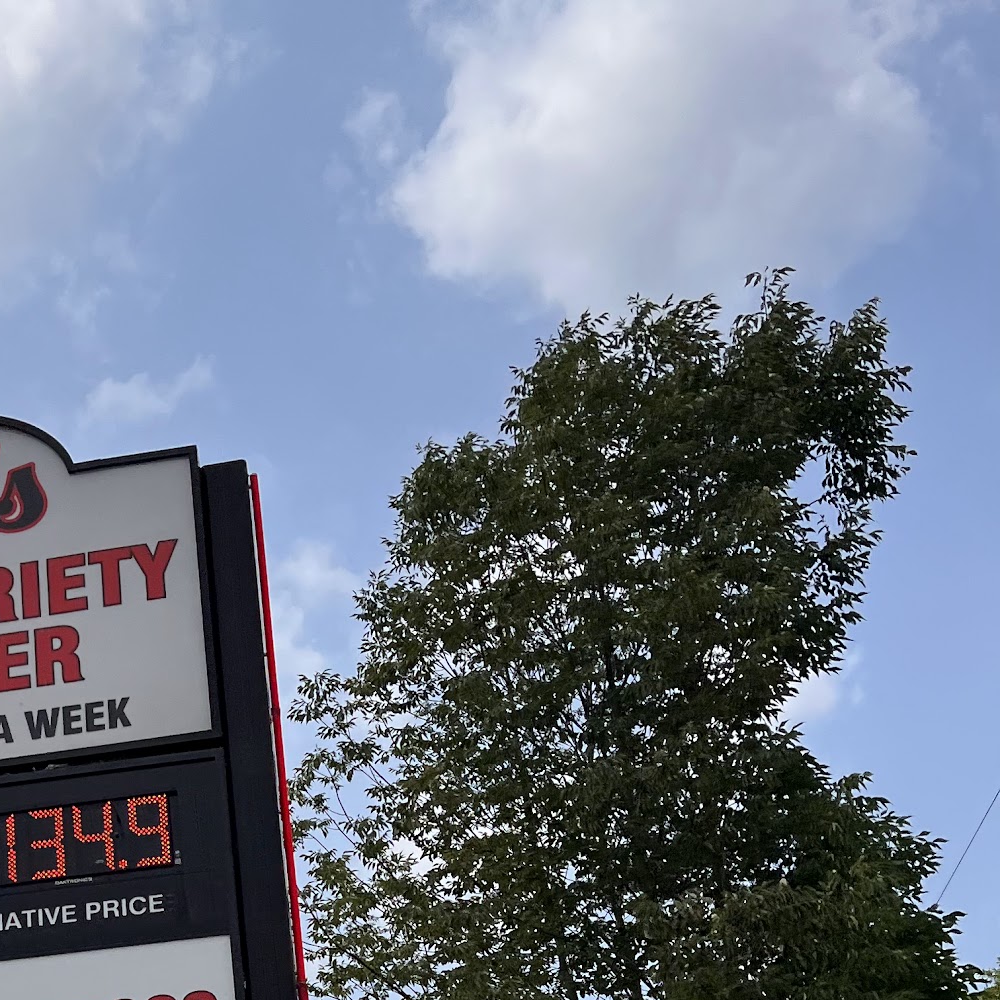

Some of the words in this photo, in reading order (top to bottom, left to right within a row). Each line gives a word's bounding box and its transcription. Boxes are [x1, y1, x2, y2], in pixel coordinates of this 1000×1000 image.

[27, 697, 132, 740] WEEK
[6, 793, 171, 883] 134.9
[85, 894, 165, 920] PRICE
